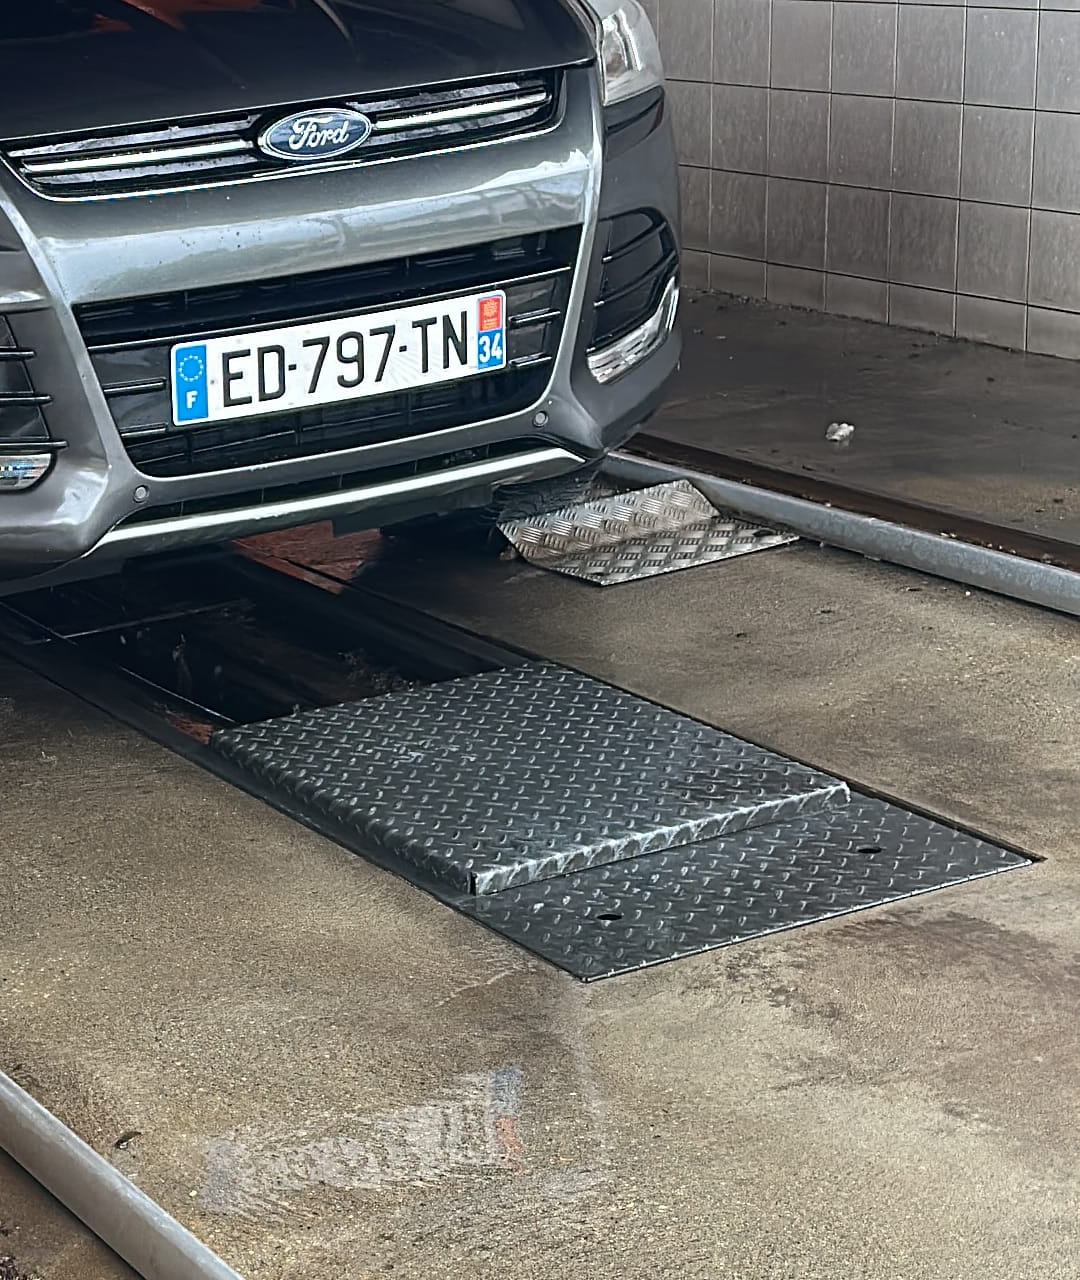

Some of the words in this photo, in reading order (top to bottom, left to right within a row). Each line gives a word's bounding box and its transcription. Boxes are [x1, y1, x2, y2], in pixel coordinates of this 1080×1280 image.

[288, 116, 350, 151] Ford
[221, 310, 469, 408] ED-797-TN
[479, 332, 503, 363] 34
[186, 390, 198, 410] F
